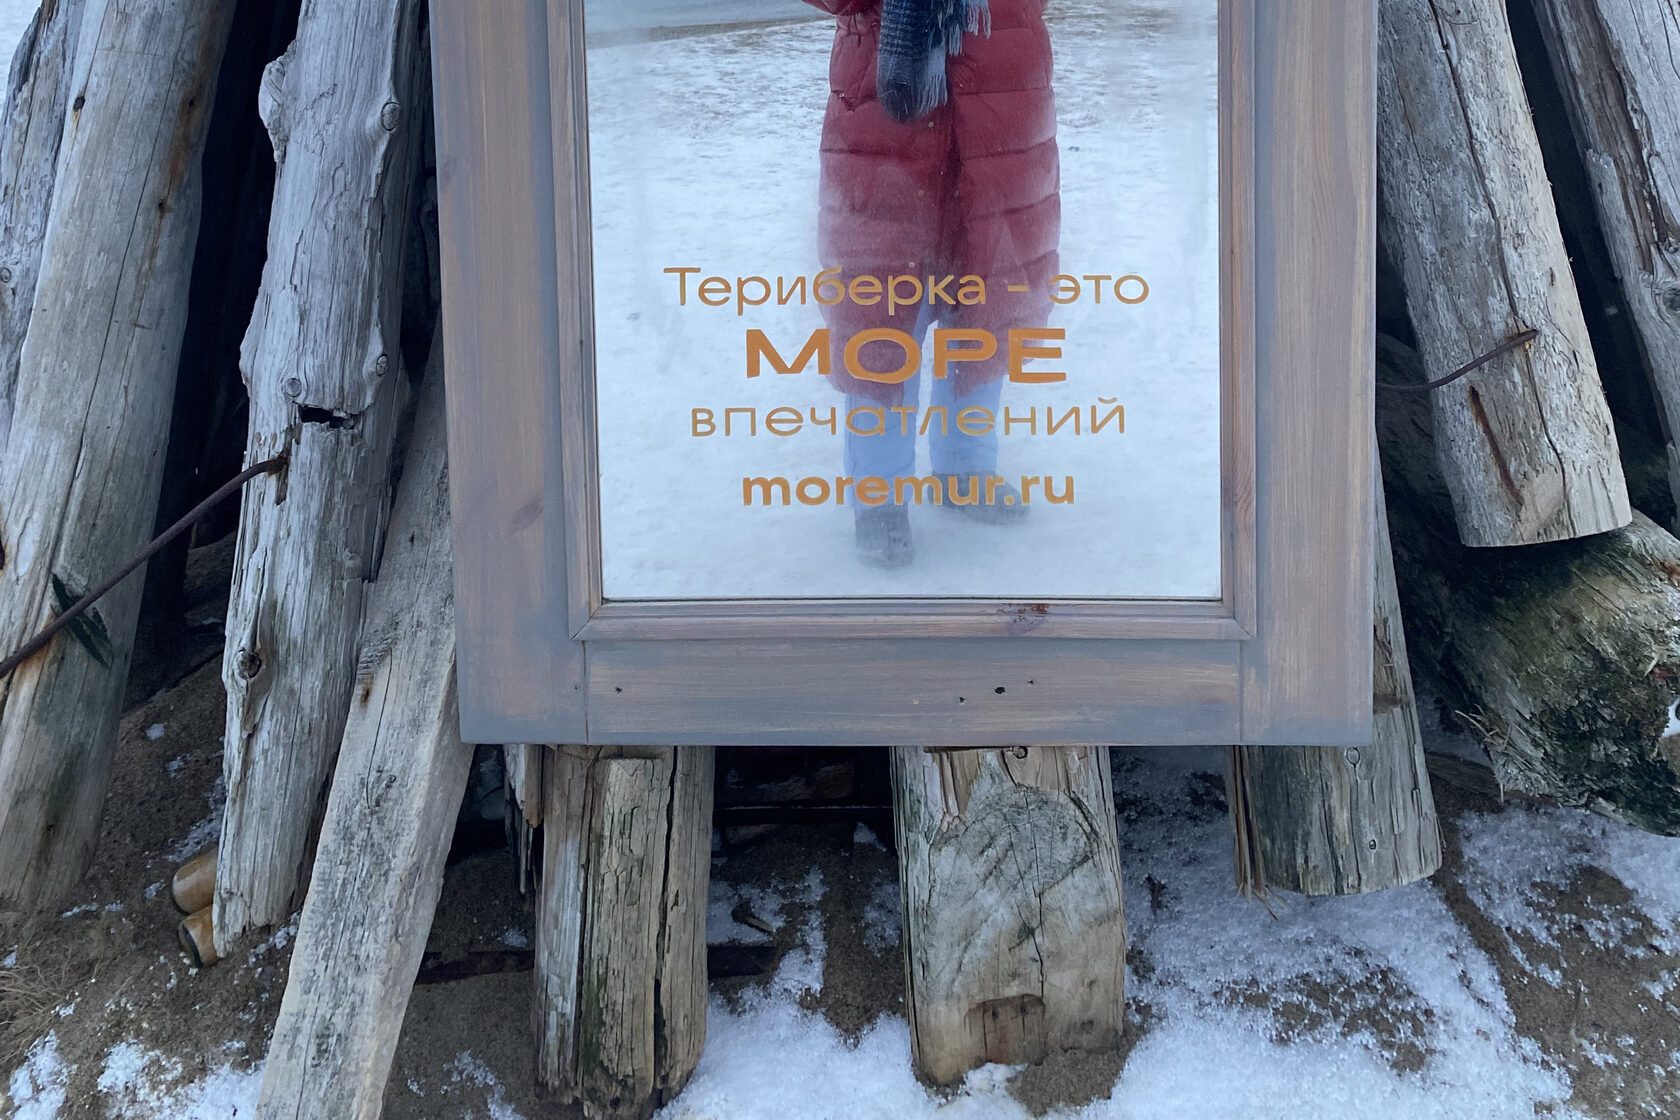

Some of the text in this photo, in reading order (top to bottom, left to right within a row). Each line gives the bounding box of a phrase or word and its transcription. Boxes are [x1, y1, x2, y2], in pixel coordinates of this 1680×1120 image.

[663, 266, 1150, 316] Териберка - это
[745, 327, 1067, 385] МОРЕ
[691, 396, 1125, 438] впечатлений
[742, 474, 1075, 507] moremur.ru
